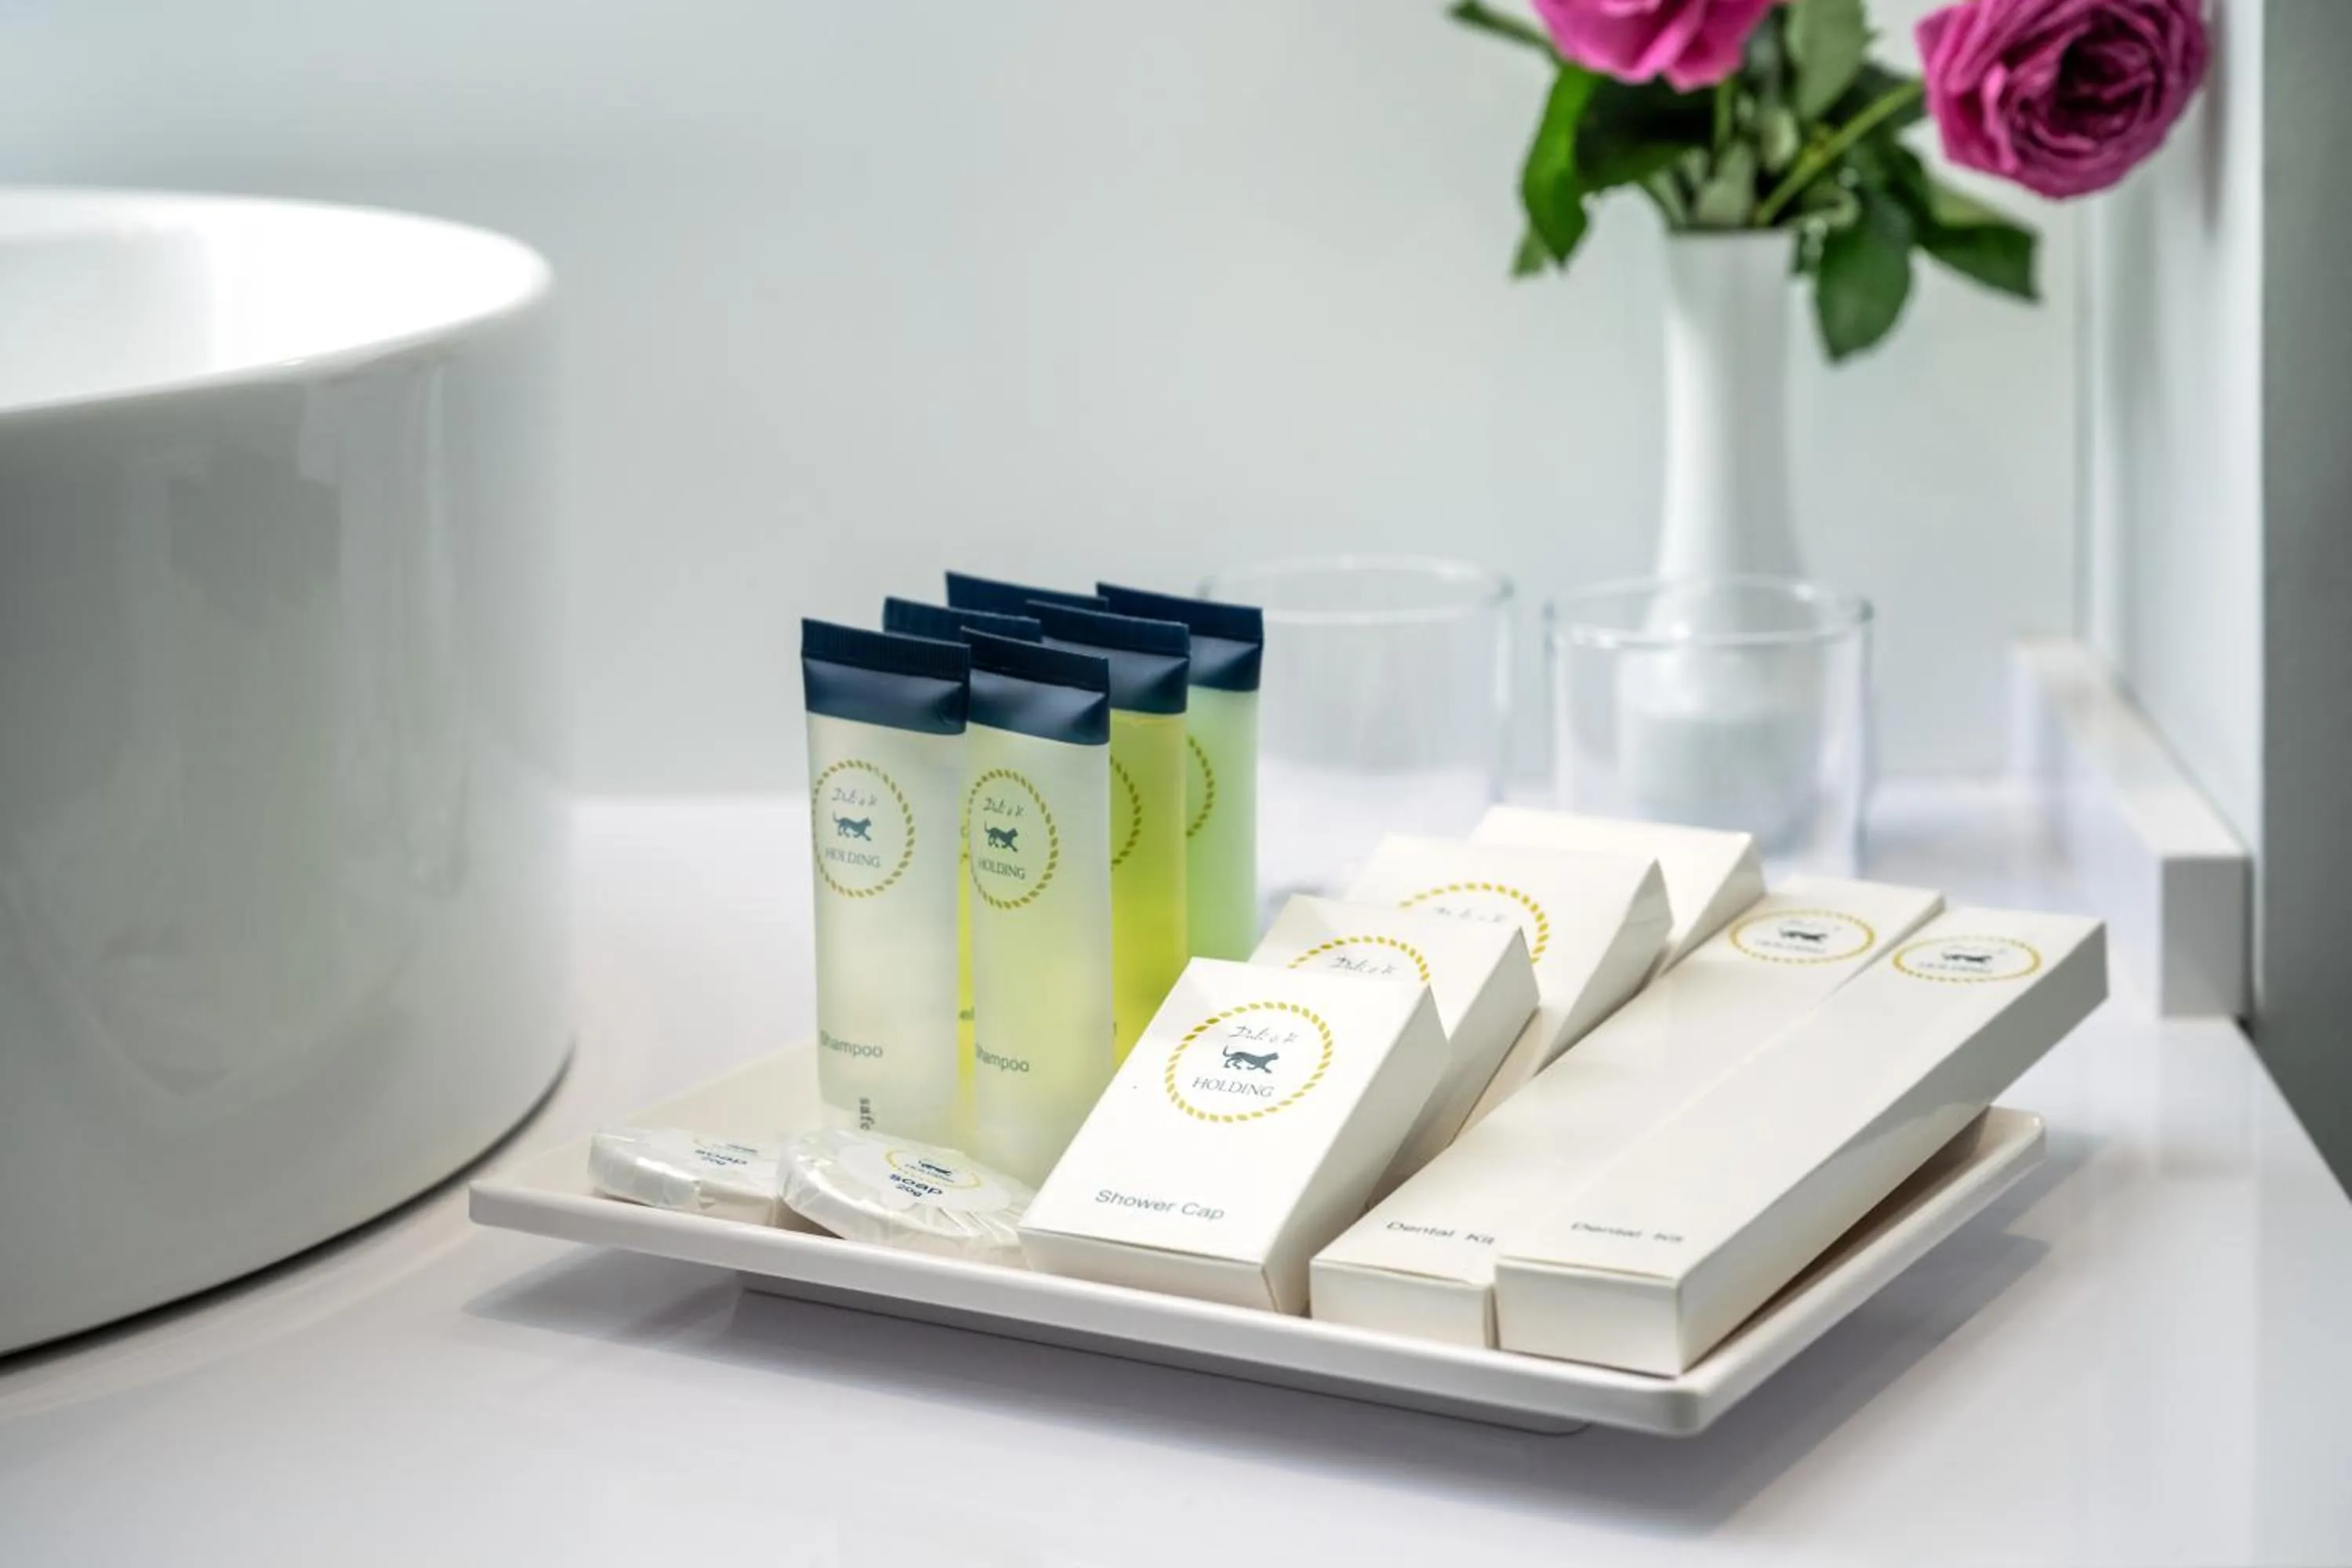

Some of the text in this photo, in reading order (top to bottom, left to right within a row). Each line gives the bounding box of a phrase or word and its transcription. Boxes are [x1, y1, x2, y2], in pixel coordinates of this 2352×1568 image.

[826, 847, 880, 869] HOLDING
[978, 858, 1025, 880] HOLDING
[820, 1029, 883, 1059] Shampoo
[1192, 1077, 1275, 1098] HOLDING
[890, 1174, 942, 1196] soap
[896, 1185, 922, 1197] 20g
[1095, 1189, 1225, 1221] Shower Cap
[1386, 1221, 1456, 1238] Dental
[1570, 1221, 1642, 1239] Dental
